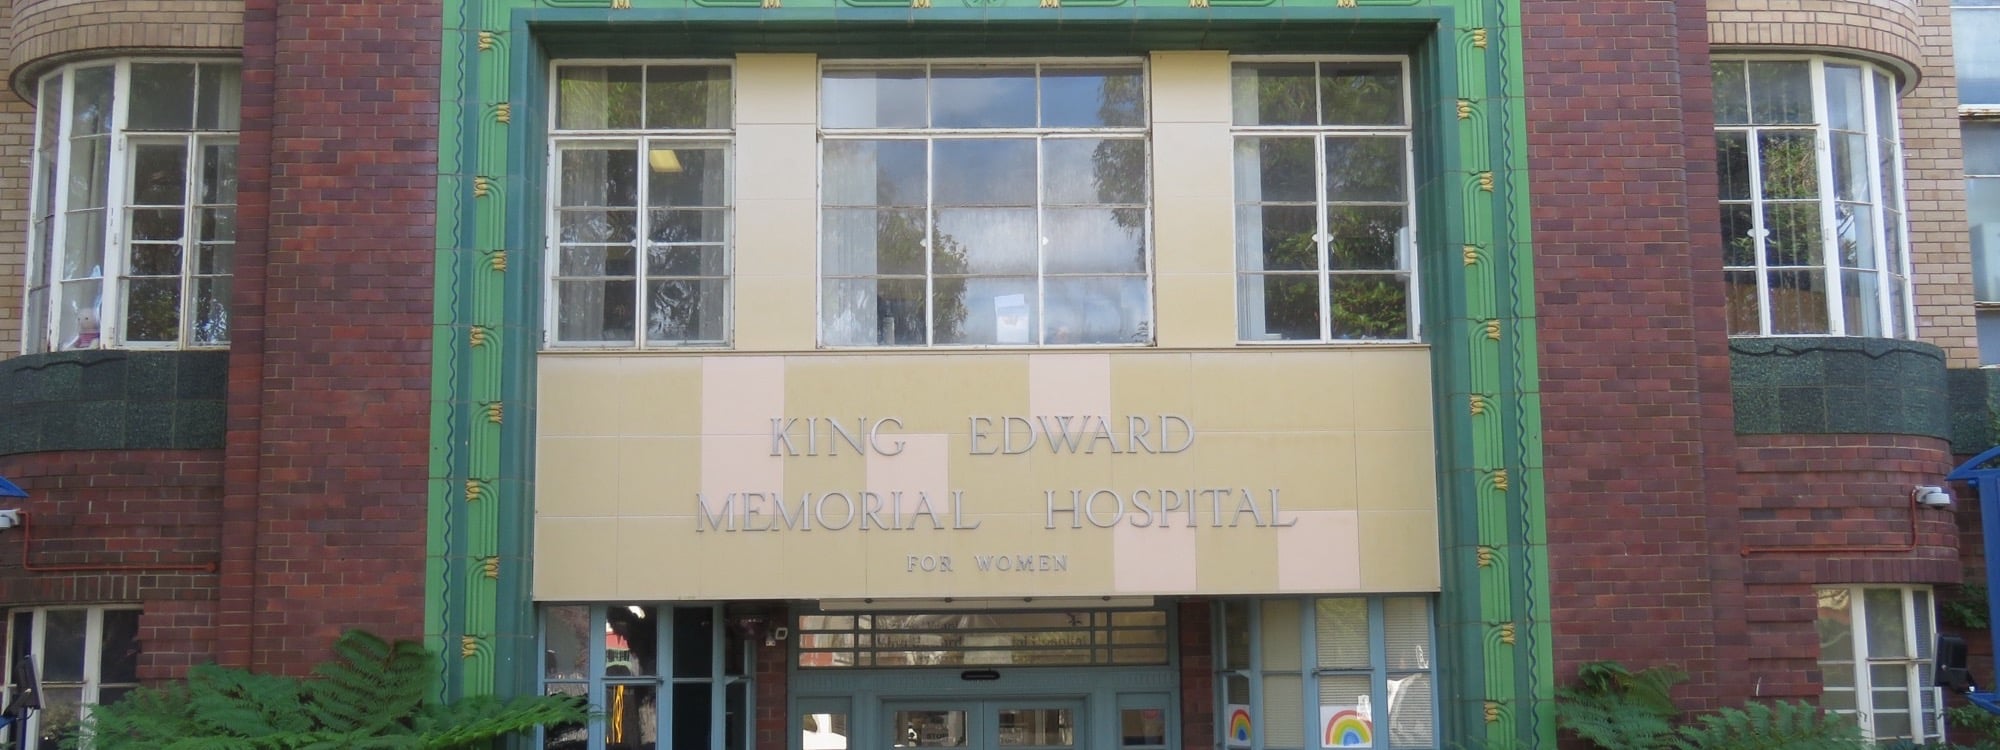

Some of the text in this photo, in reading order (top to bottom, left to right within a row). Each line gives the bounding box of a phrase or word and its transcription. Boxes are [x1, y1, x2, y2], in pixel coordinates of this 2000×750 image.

[769, 415, 1196, 457] KING EDWARD
[695, 487, 1299, 532] MEMORIAL HOSPITAL
[906, 554, 1068, 573] FOR WOMEN
